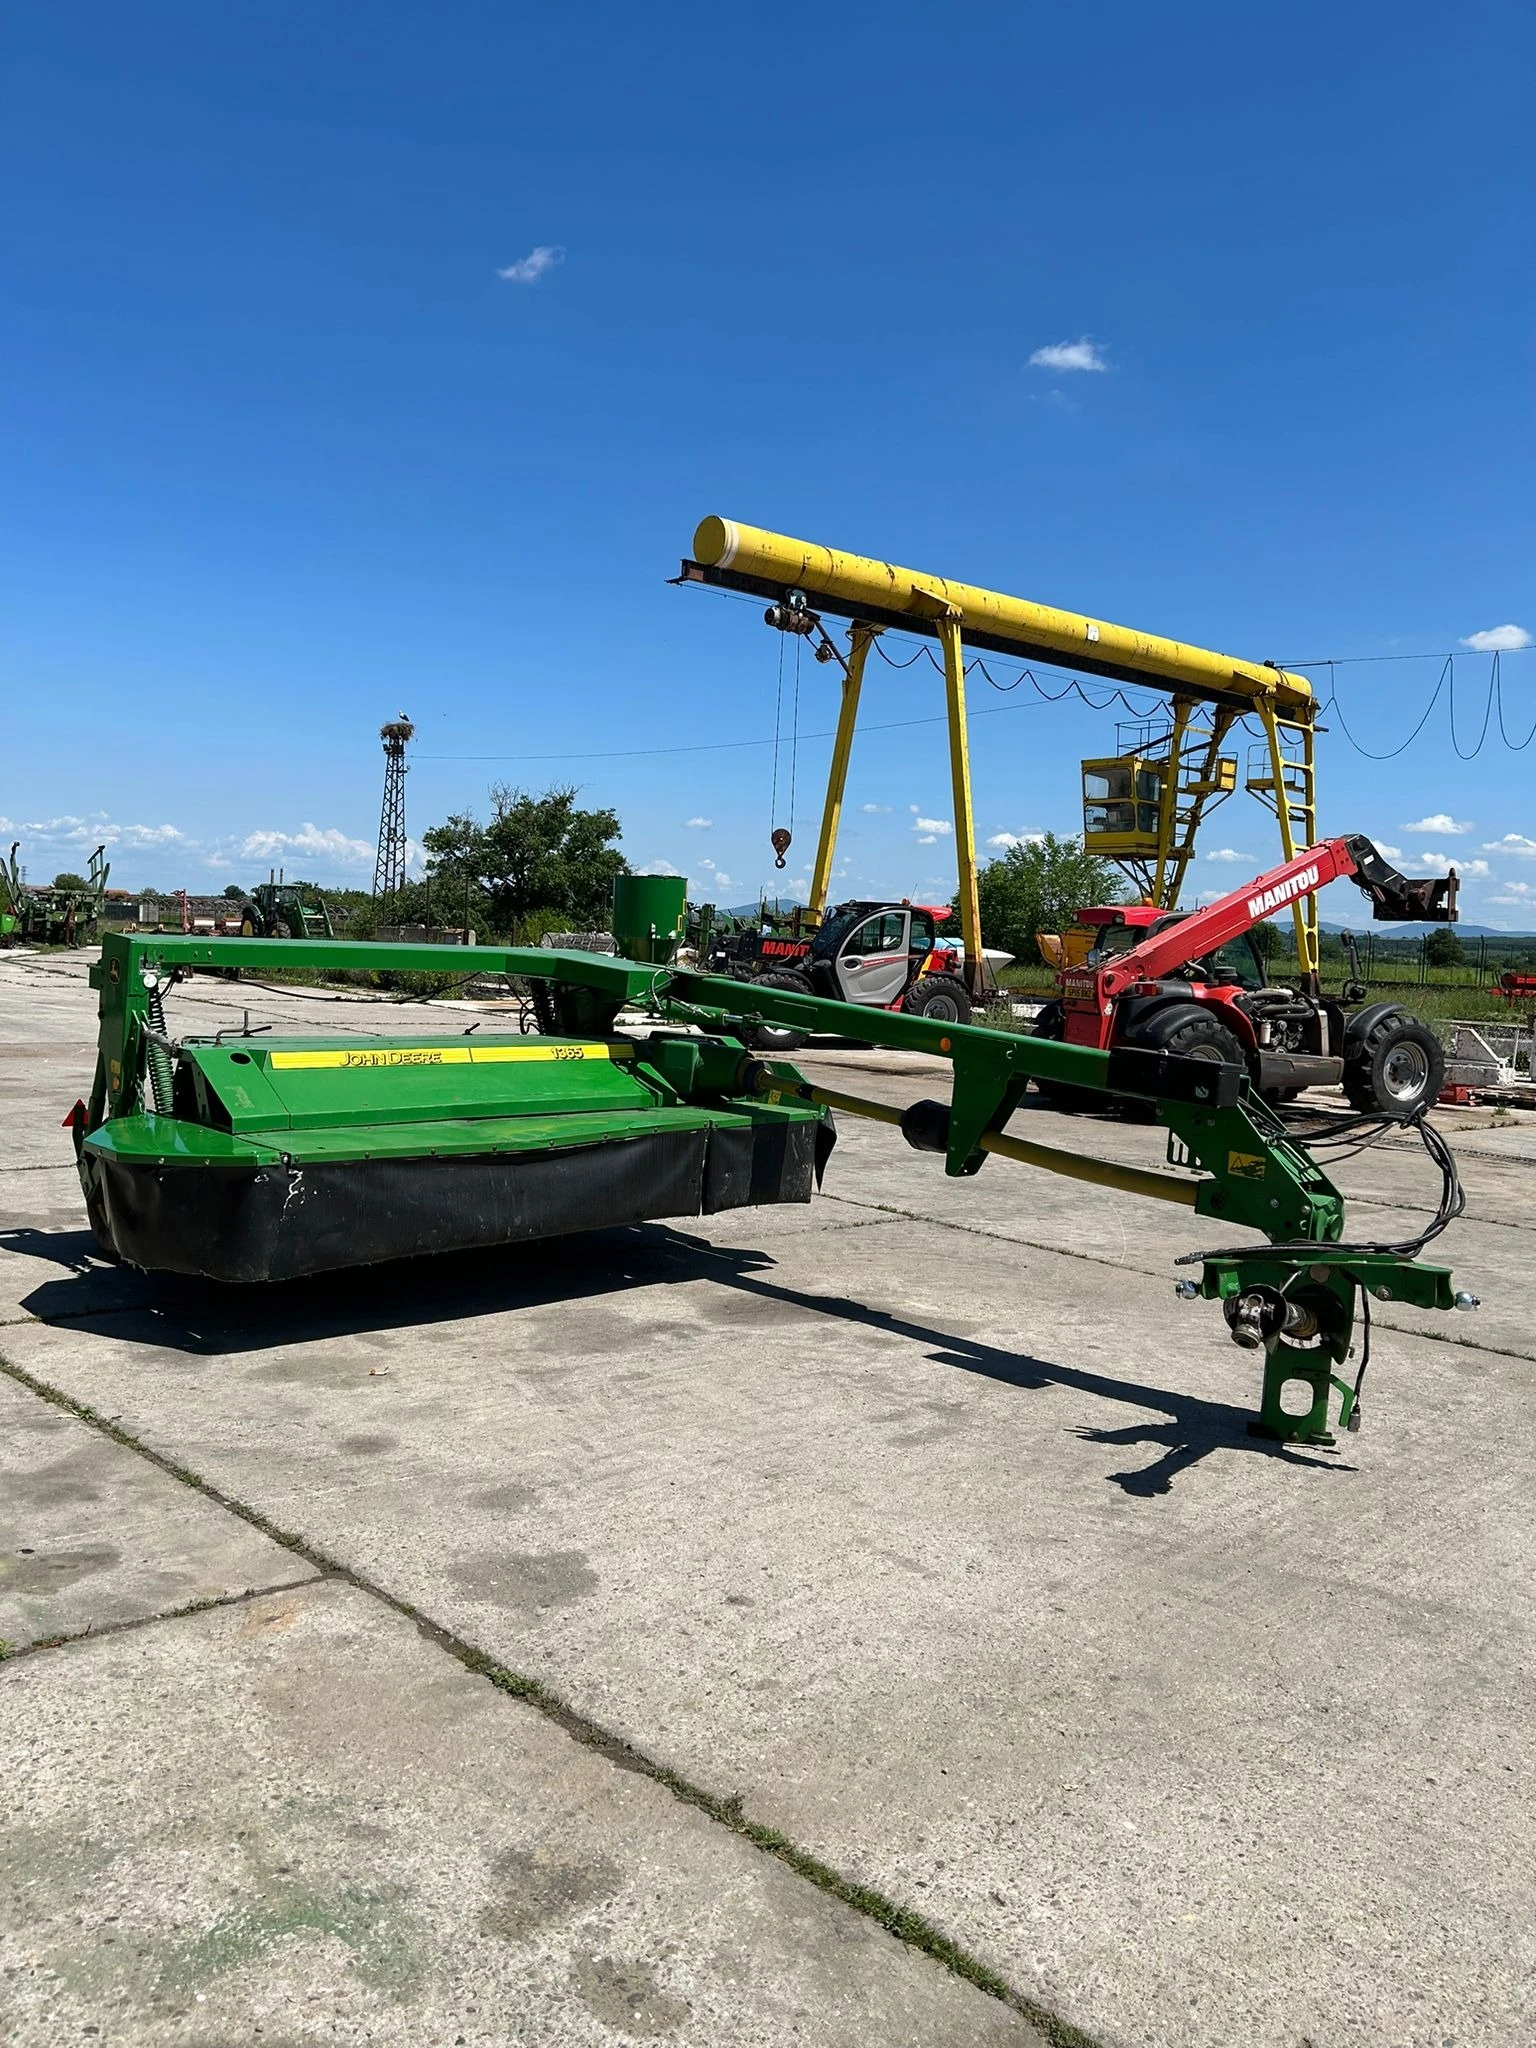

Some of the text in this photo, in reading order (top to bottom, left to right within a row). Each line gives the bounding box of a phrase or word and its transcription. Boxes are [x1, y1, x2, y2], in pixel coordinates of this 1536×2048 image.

[1247, 864, 1319, 919] MANITOU
[762, 941, 810, 957] MANIT
[1065, 979, 1095, 989] MANITOU
[340, 1051, 443, 1066] JOHN DEERE
[551, 1047, 585, 1059] 1365
